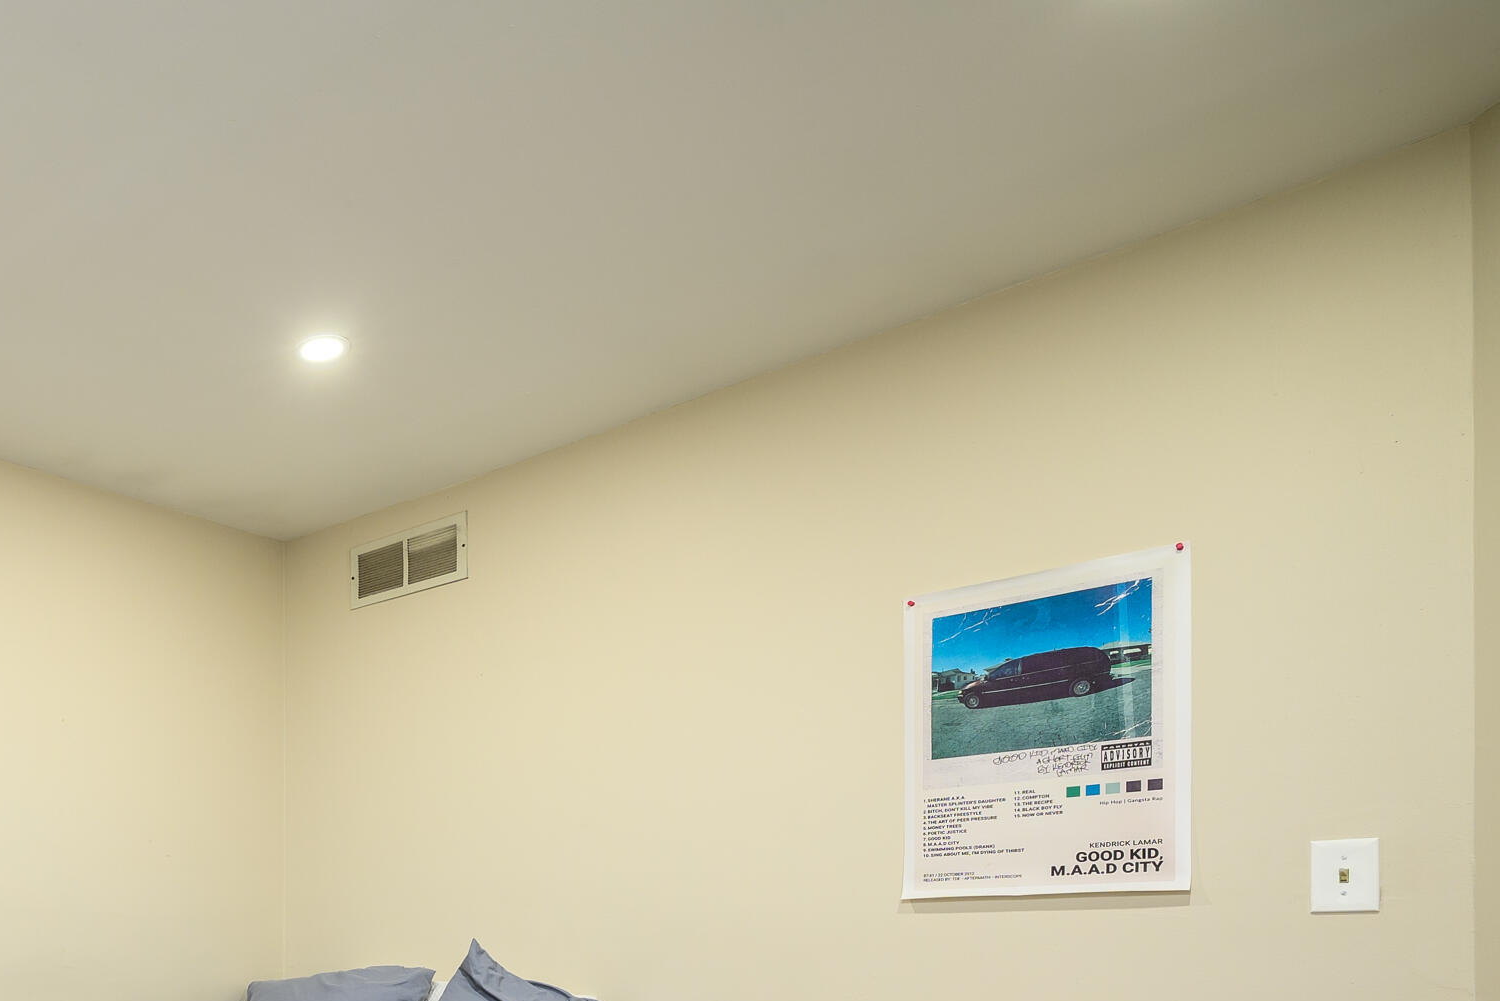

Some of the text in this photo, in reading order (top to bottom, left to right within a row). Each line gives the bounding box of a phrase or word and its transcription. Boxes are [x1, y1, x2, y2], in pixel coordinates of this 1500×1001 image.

[1103, 747, 1150, 762] ADVISORY
[1103, 759, 1150, 770] EXPLICIT CONTENT
[1089, 838, 1164, 848] KENDRICK LAMAR
[1076, 848, 1164, 863] GOOD KID,
[1050, 860, 1164, 877] M.A.A.D CITY
